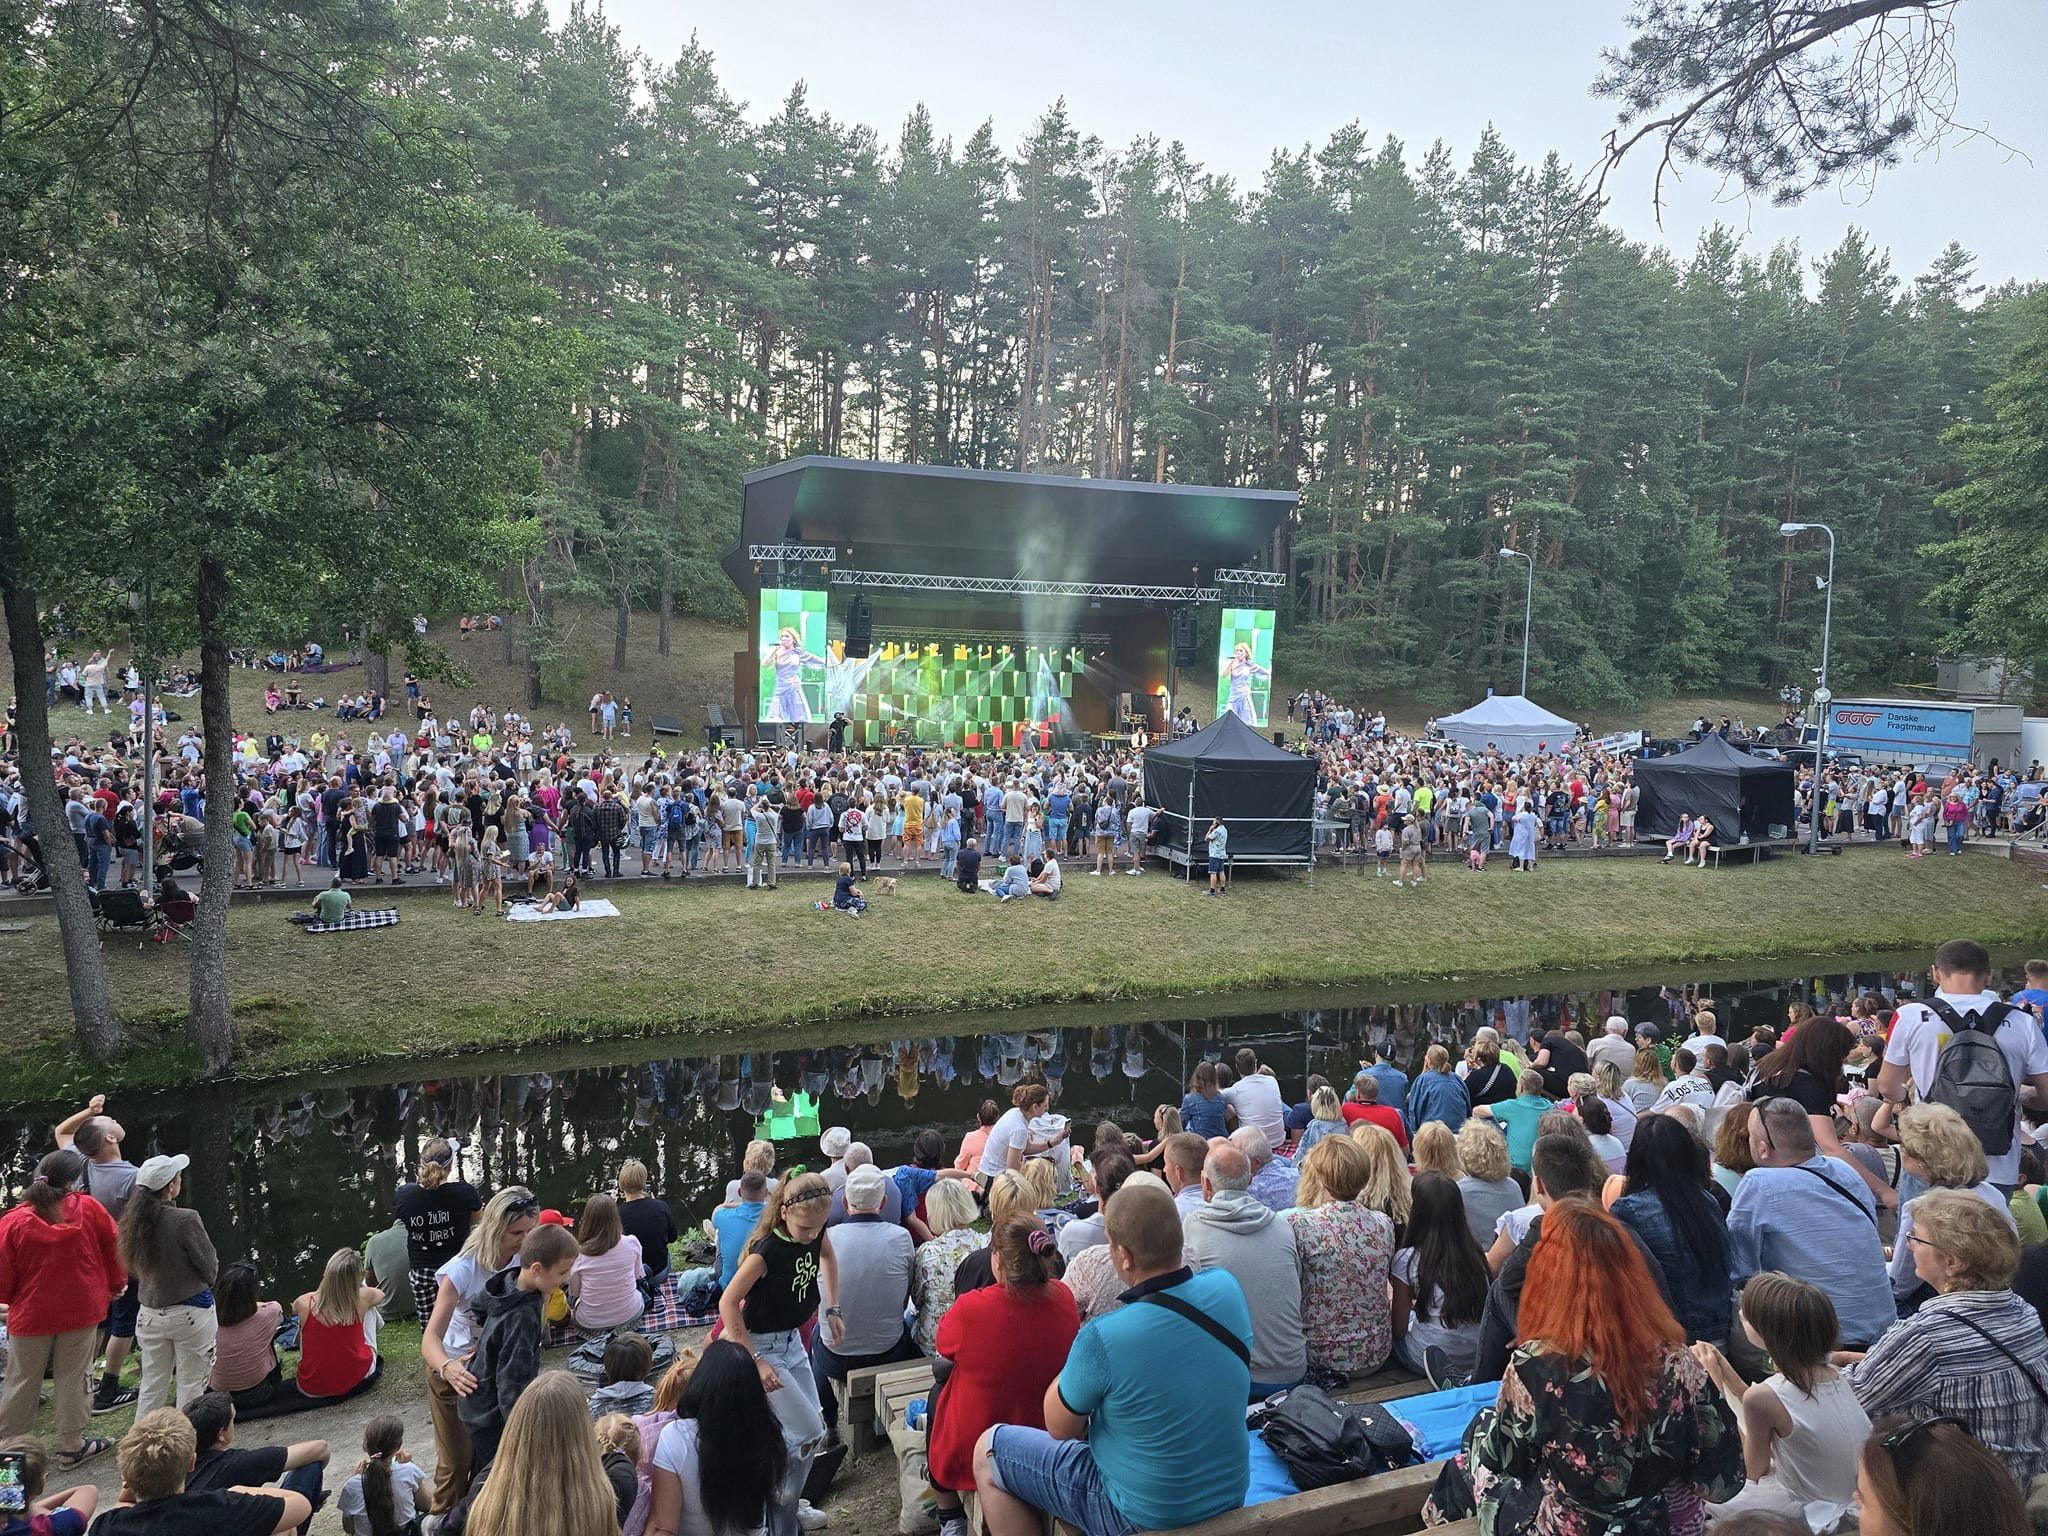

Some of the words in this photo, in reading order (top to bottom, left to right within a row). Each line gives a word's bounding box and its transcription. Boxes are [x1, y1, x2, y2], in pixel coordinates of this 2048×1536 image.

[1887, 713, 1919, 722] Danske
[1887, 721, 1936, 733] Fragtmænd
[1664, 1084, 1691, 1103] Los
[410, 1215, 424, 1227] KO
[429, 1226, 456, 1242] DIRBT
[795, 1251, 813, 1274] GO
[791, 1264, 817, 1292] FOR
[798, 1282, 810, 1303] IT
